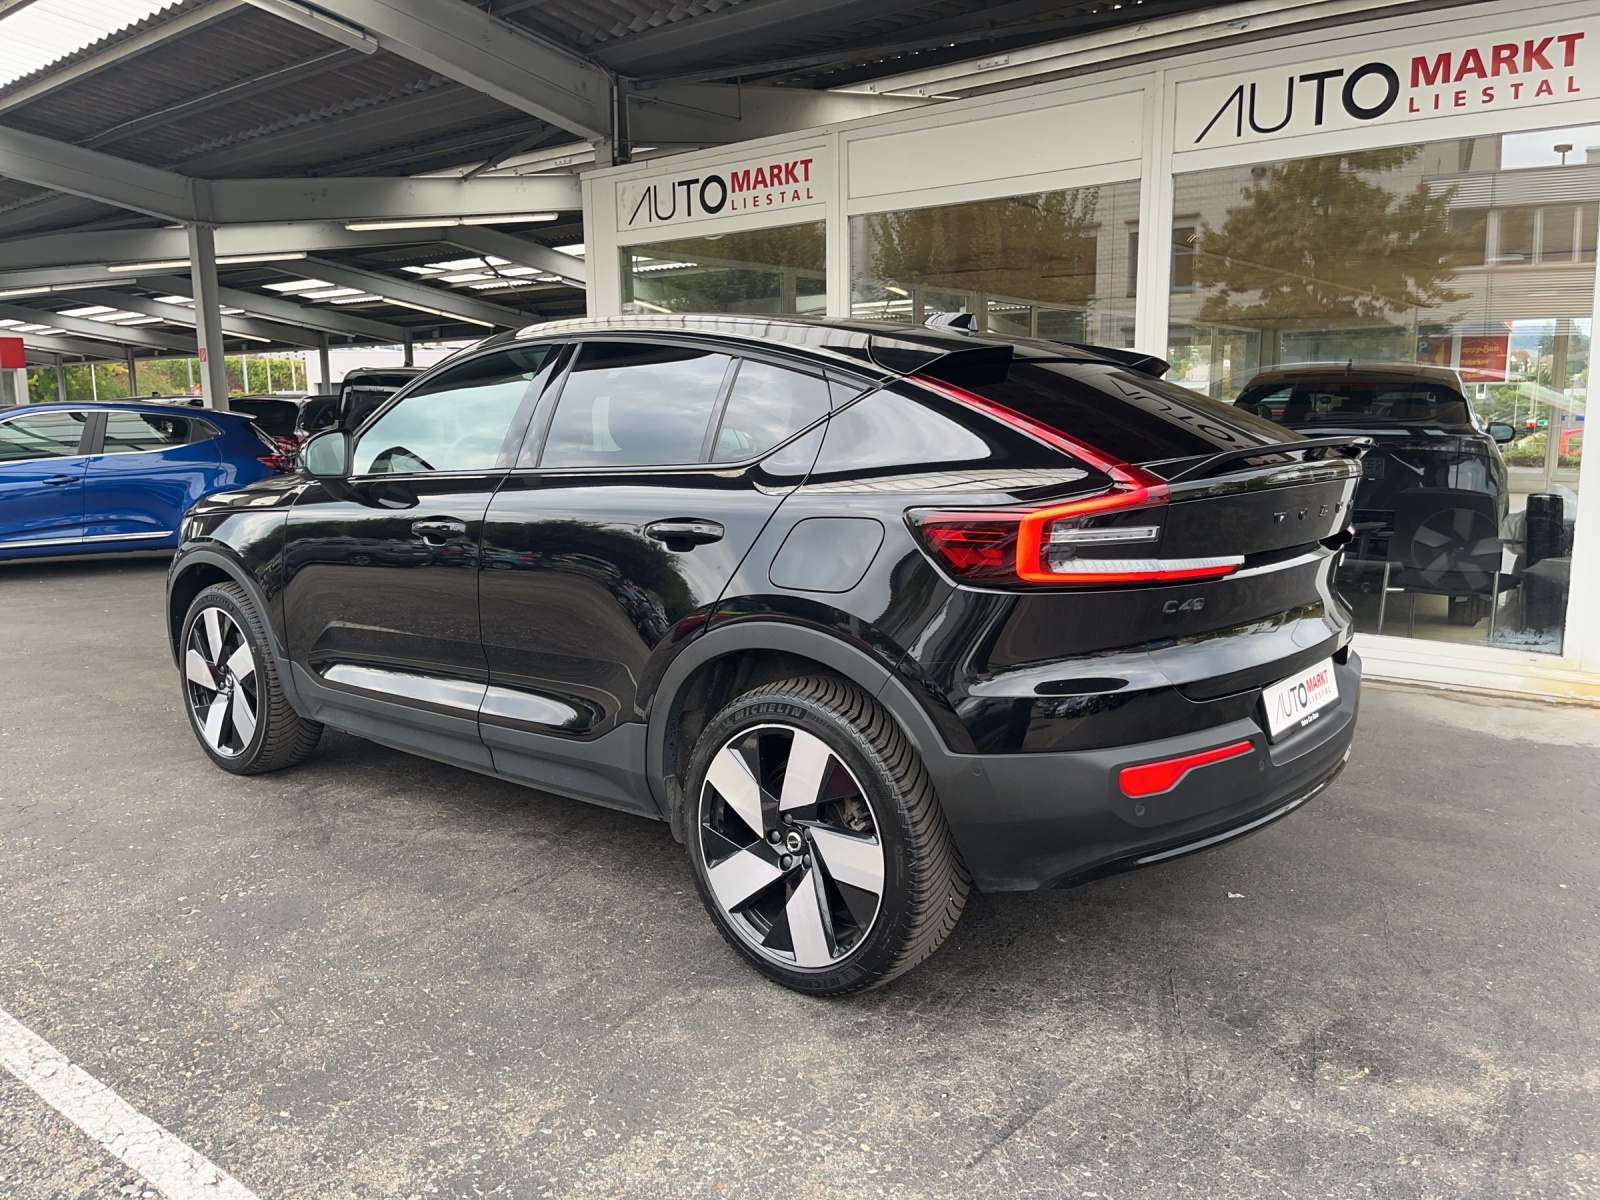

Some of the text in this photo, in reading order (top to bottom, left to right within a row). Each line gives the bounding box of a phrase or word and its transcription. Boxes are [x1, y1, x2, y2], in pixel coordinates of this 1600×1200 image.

[1193, 32, 1585, 144] AUTO MARKT
[1408, 75, 1581, 113] LIESTAL
[628, 158, 813, 225] AUTO MARKT
[731, 187, 813, 211] LIESTAL
[1161, 597, 1206, 614] C40
[1276, 669, 1329, 725] AUTO MARKT
[1308, 686, 1332, 704] LIESTAL
[734, 703, 802, 721] MICHELIN
